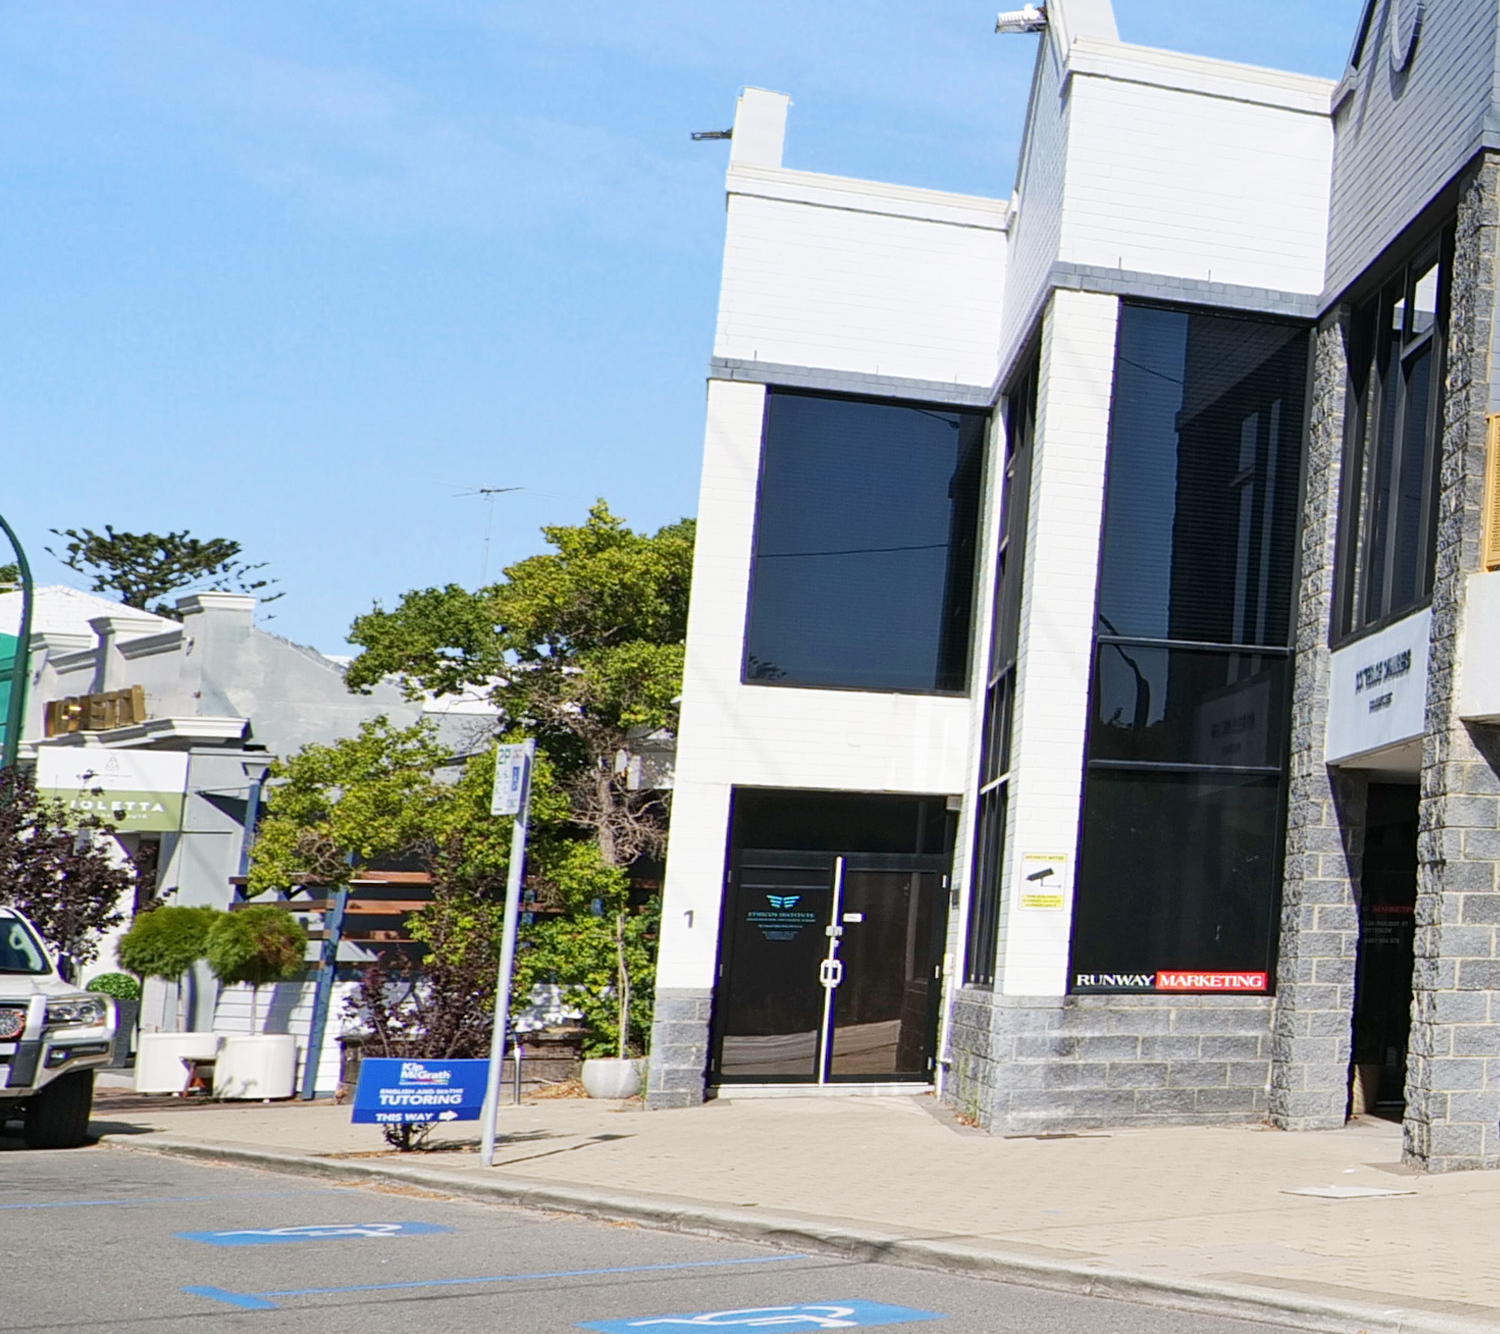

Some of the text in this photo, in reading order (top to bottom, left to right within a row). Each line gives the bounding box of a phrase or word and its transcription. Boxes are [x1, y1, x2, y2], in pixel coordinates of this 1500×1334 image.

[684, 910, 694, 929] 1
[1076, 974, 1263, 987] RUNWAY MARKETING
[402, 1062, 424, 1072] Kip
[401, 1070, 451, 1079] McGrath
[379, 1094, 463, 1105] TUTORING
[375, 1112, 434, 1122] THIS WAY
